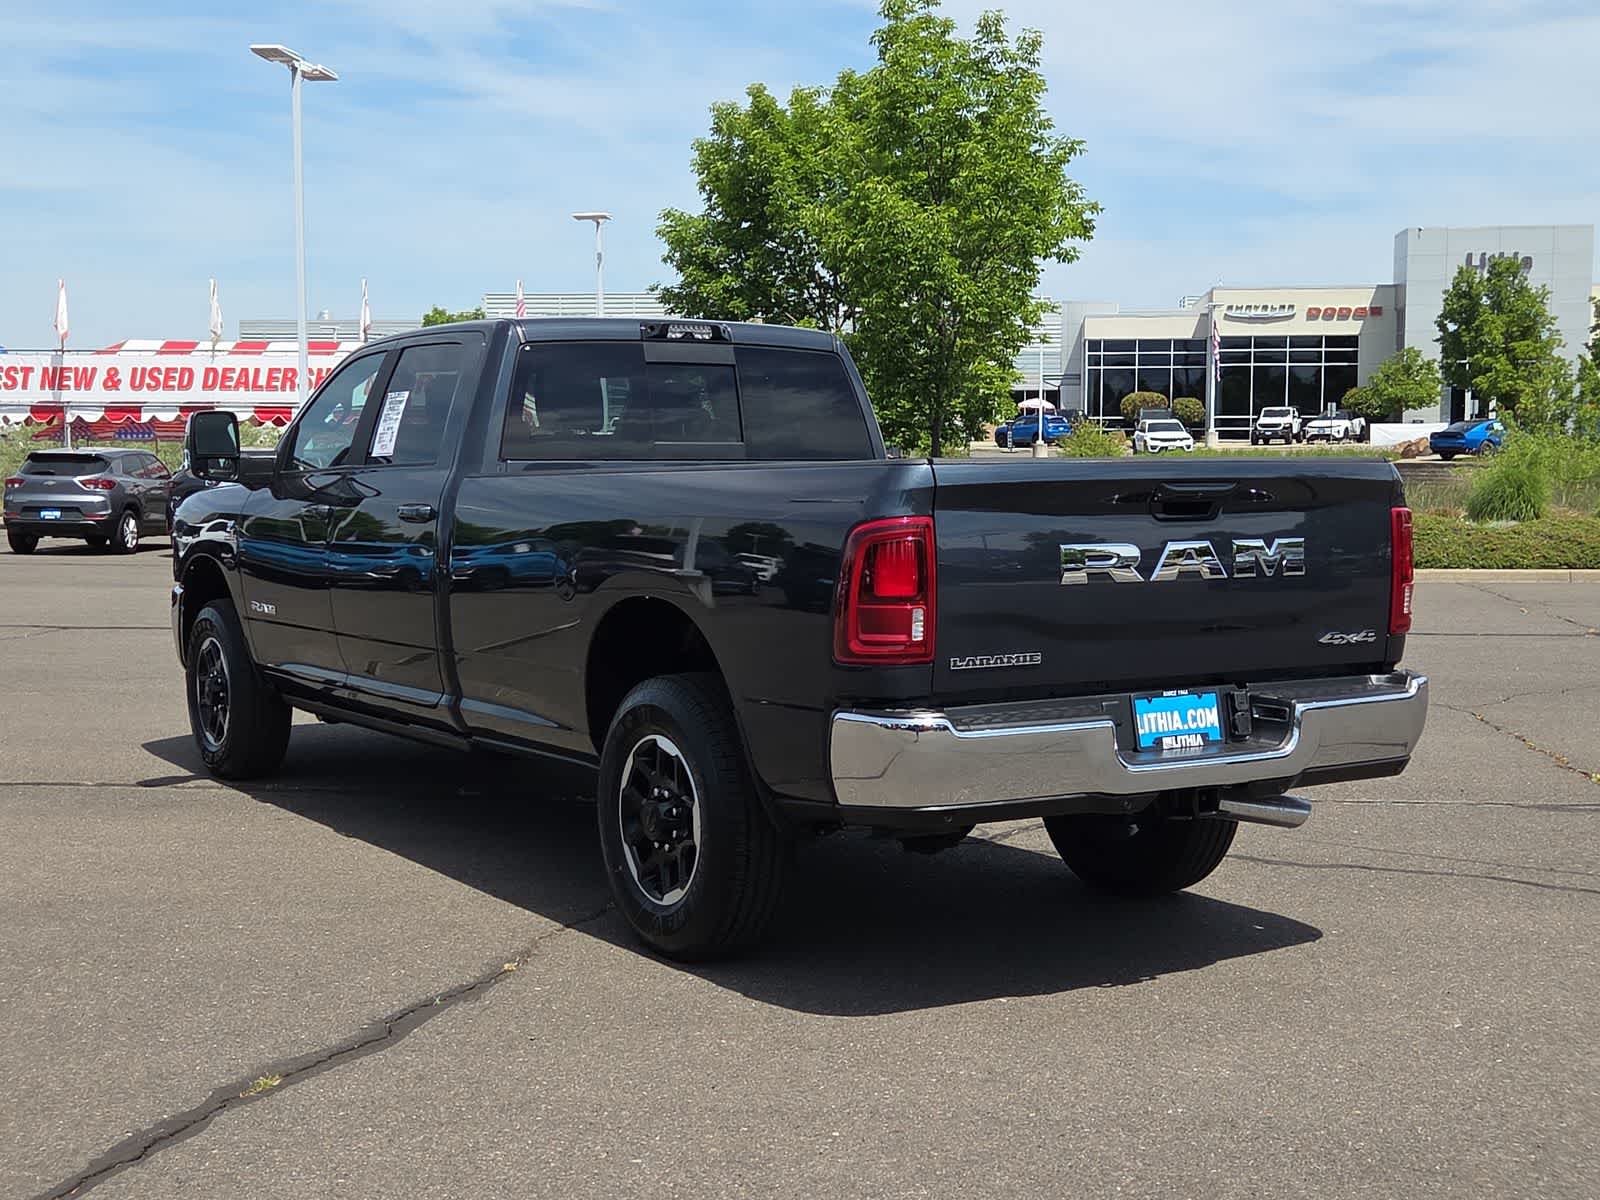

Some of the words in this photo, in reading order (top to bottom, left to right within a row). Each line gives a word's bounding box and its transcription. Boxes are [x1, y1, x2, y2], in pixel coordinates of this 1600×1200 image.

[1306, 306, 1383, 321] DODGE
[40, 366, 97, 391] NEW
[103, 366, 122, 391] &
[129, 366, 194, 391] USED
[1059, 537, 1306, 585] RAM
[250, 600, 276, 615] RAM
[950, 652, 1041, 669] LARAMIE
[1137, 705, 1219, 735] LITHIA.COM
[1172, 733, 1204, 748] LITHIA
